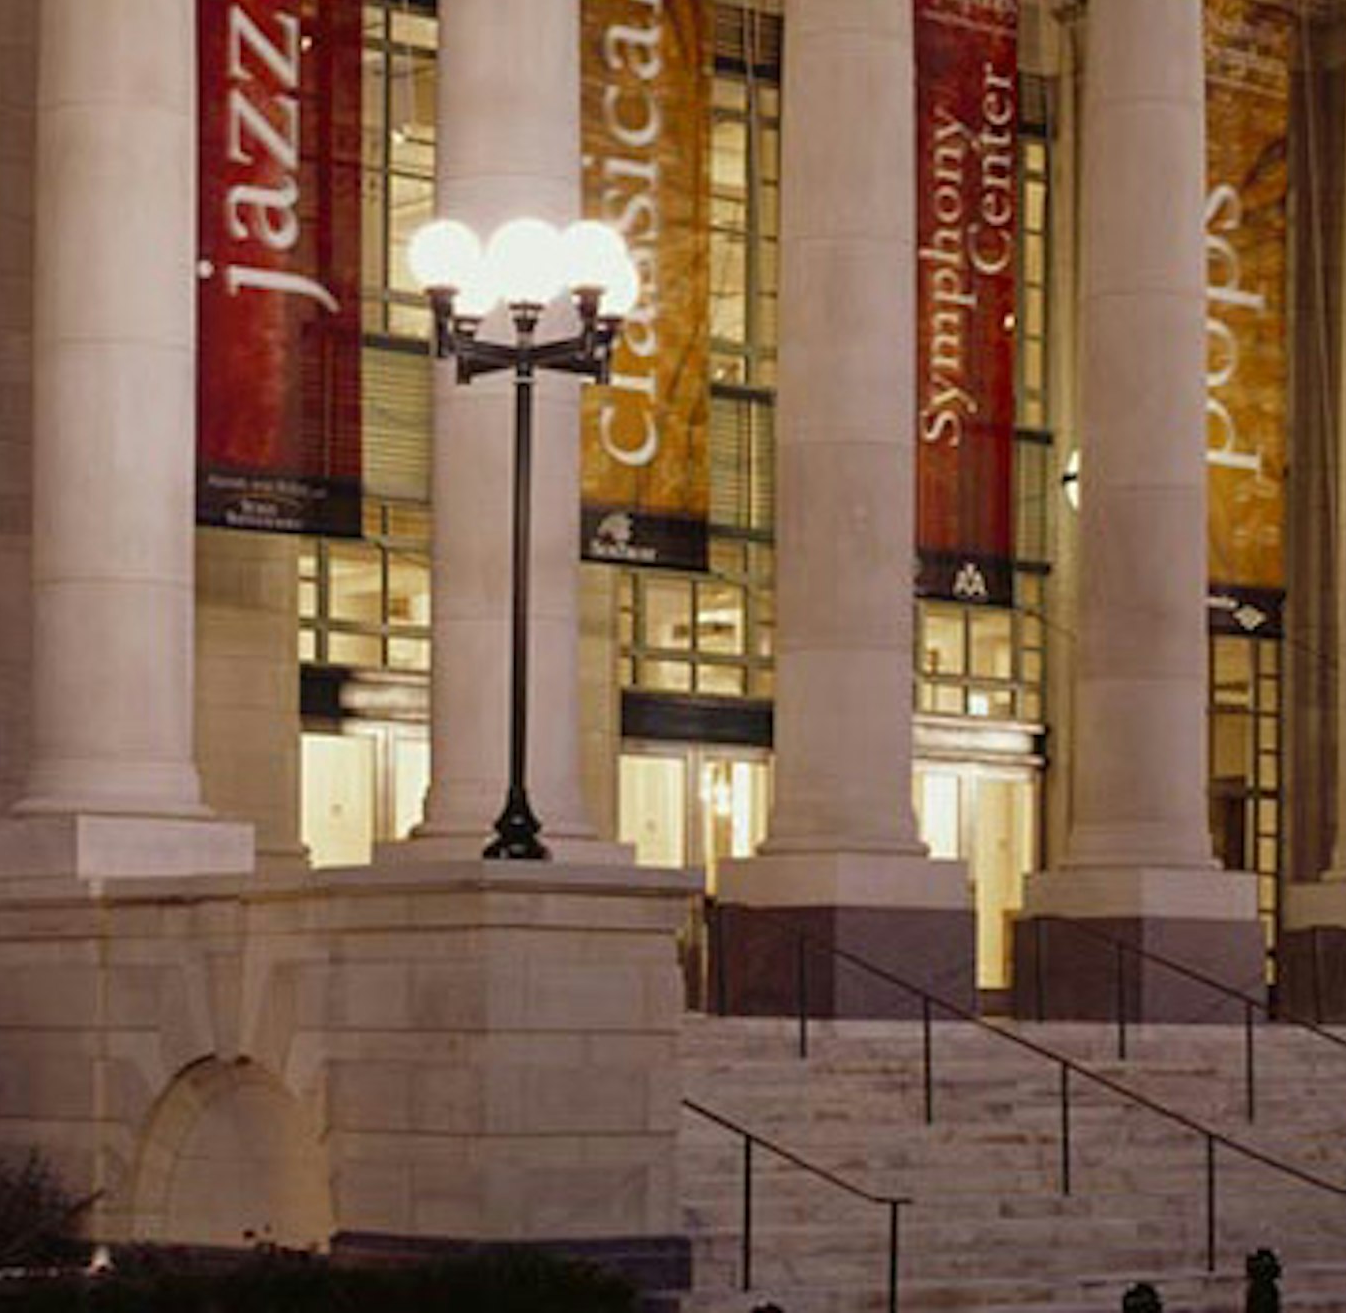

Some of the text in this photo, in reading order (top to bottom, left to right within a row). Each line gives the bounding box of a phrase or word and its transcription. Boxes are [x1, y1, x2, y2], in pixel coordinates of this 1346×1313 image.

[199, 4, 340, 314] jazz
[919, 106, 977, 447] Symphony
[967, 62, 1014, 276] Center
[1206, 185, 1266, 469] pops
